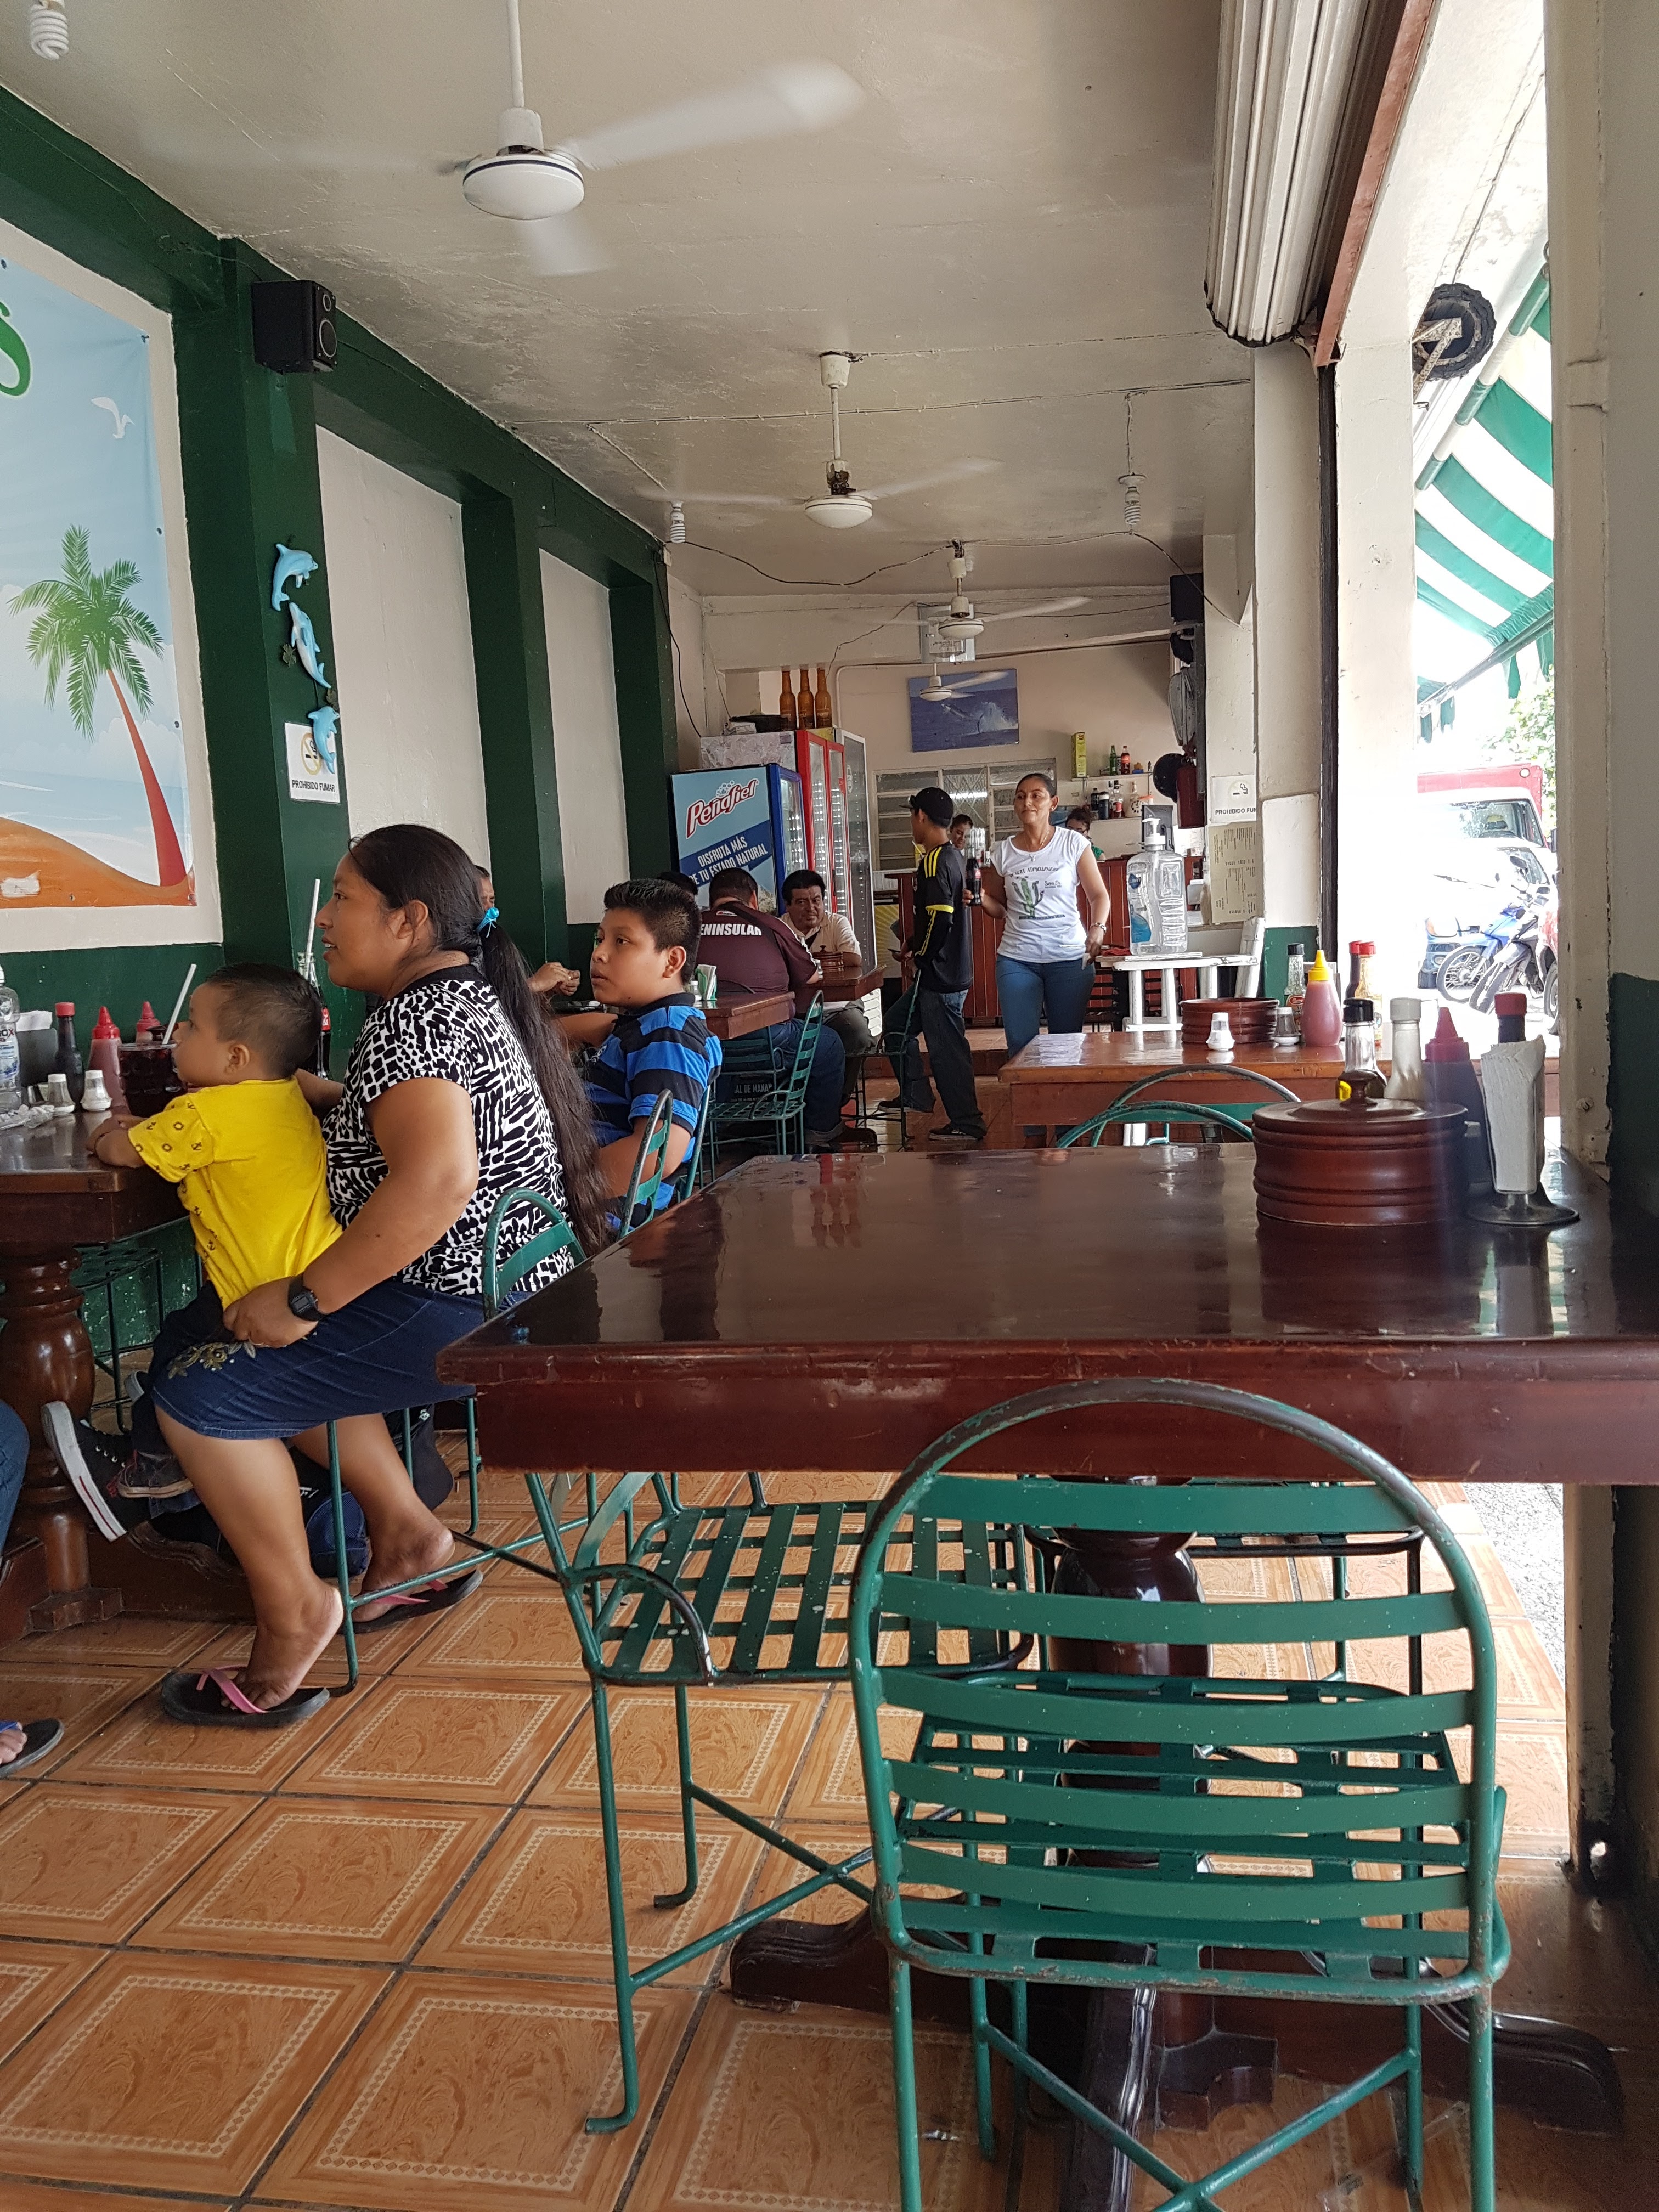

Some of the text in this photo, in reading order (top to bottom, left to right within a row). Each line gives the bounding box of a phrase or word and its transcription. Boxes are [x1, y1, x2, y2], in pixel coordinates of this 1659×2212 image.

[291, 780, 335, 792] PROHIBIDO FUMAR
[686, 778, 758, 839] Peñafiel
[697, 836, 748, 867] DISFRUTA MÁS
[698, 871, 710, 883] TU
[710, 857, 736, 878] ESTADO
[735, 843, 768, 866] NATURAL
[0, 1028, 14, 1037] OX
[744, 1084, 751, 1093] DE
